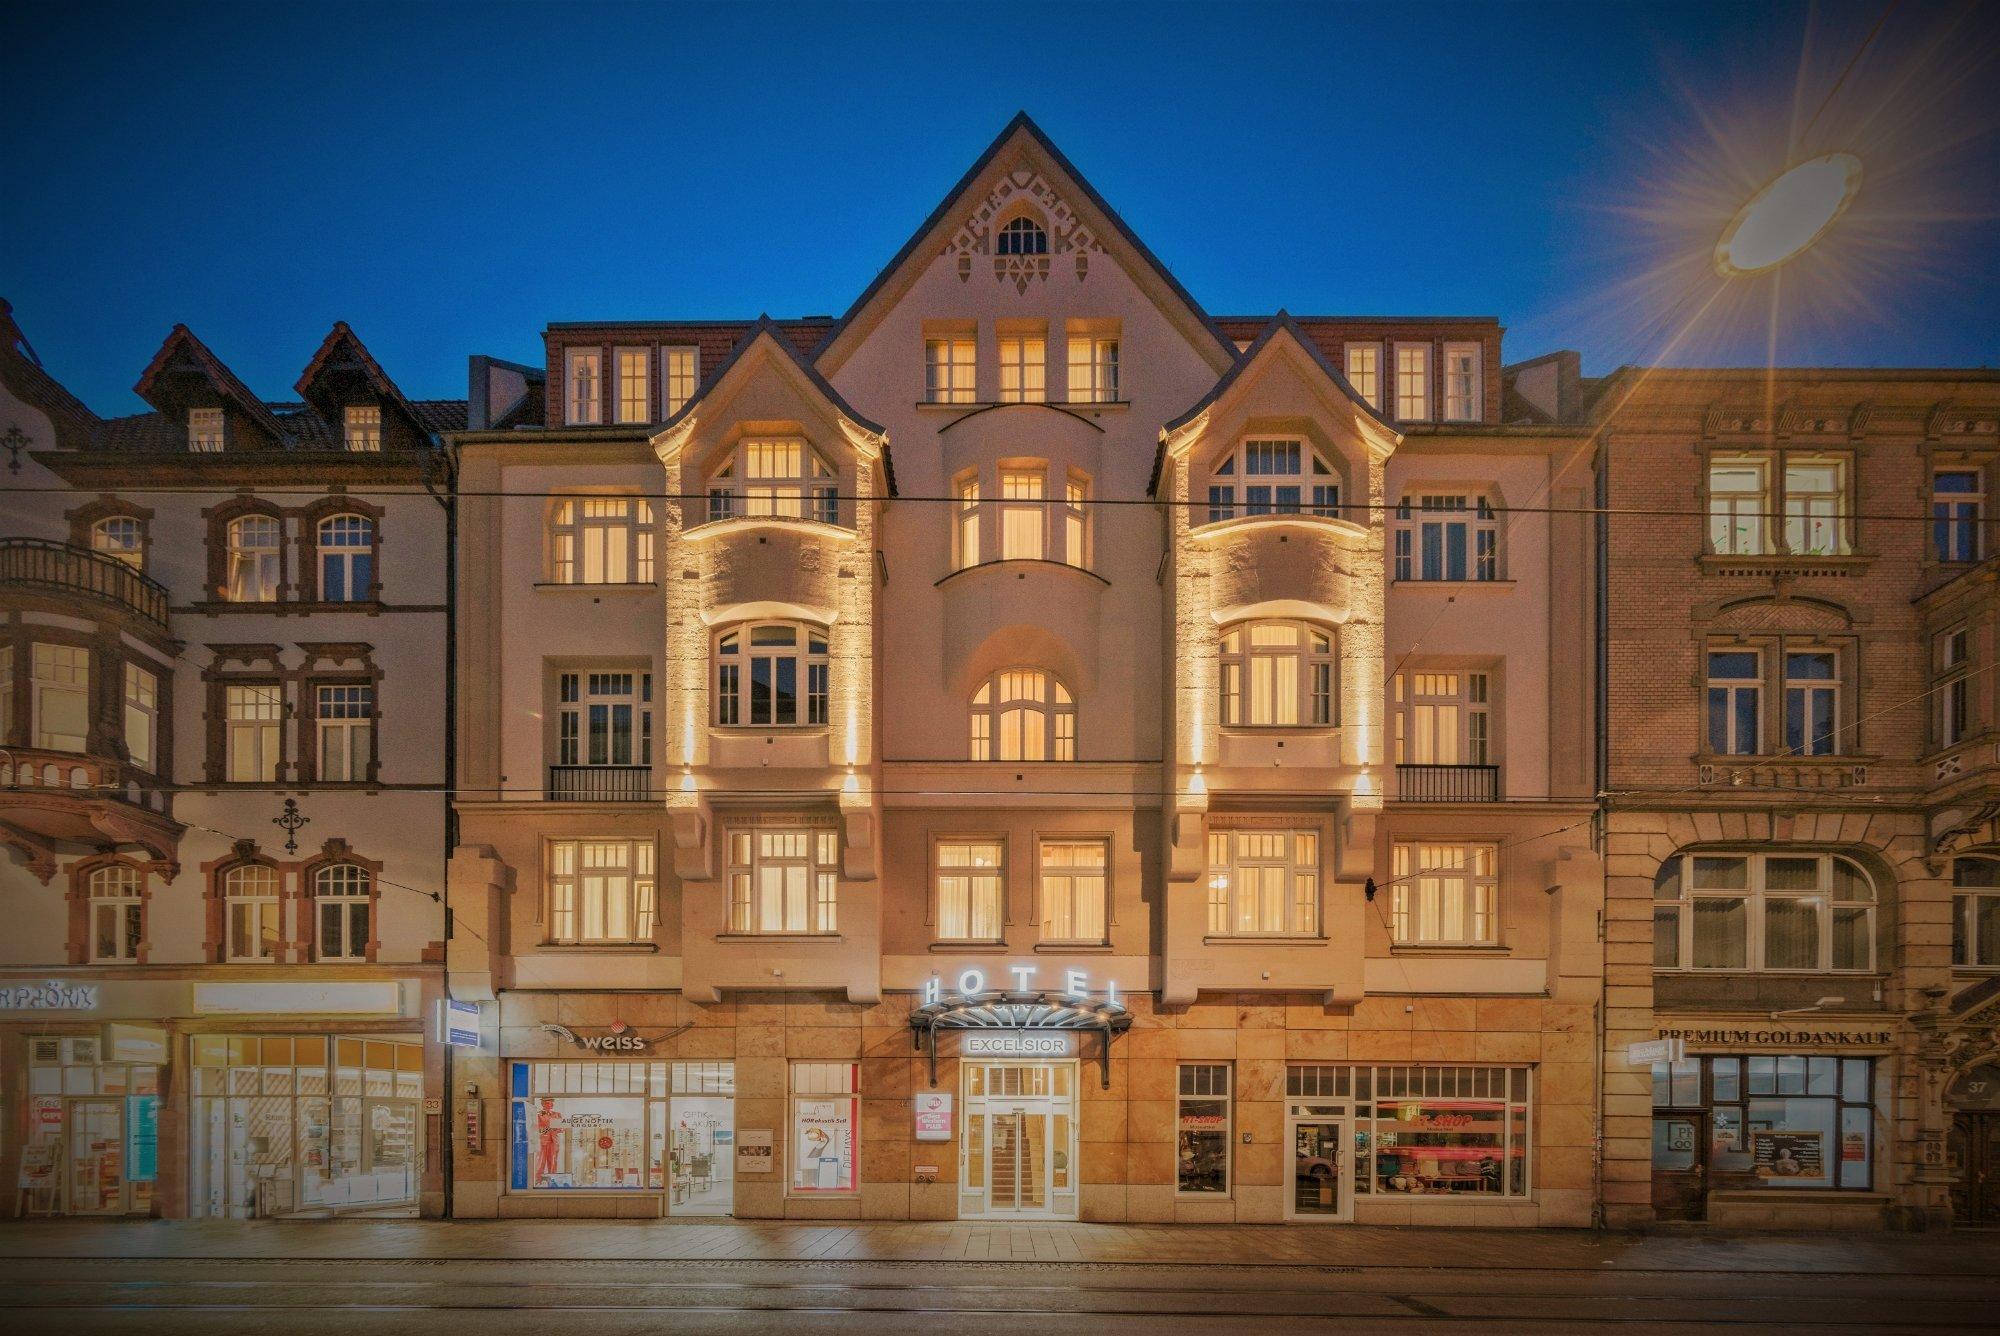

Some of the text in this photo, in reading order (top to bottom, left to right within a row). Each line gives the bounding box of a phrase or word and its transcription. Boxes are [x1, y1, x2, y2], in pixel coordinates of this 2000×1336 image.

[925, 966, 1121, 1005] HOTEL
[583, 1036, 644, 1050] weiss
[1658, 1029, 1892, 1045] PREMIUM GOLDANKAUF
[969, 1039, 1064, 1051] EXCELSIOR
[1968, 1081, 1987, 1093] 37
[426, 1100, 439, 1109] 33
